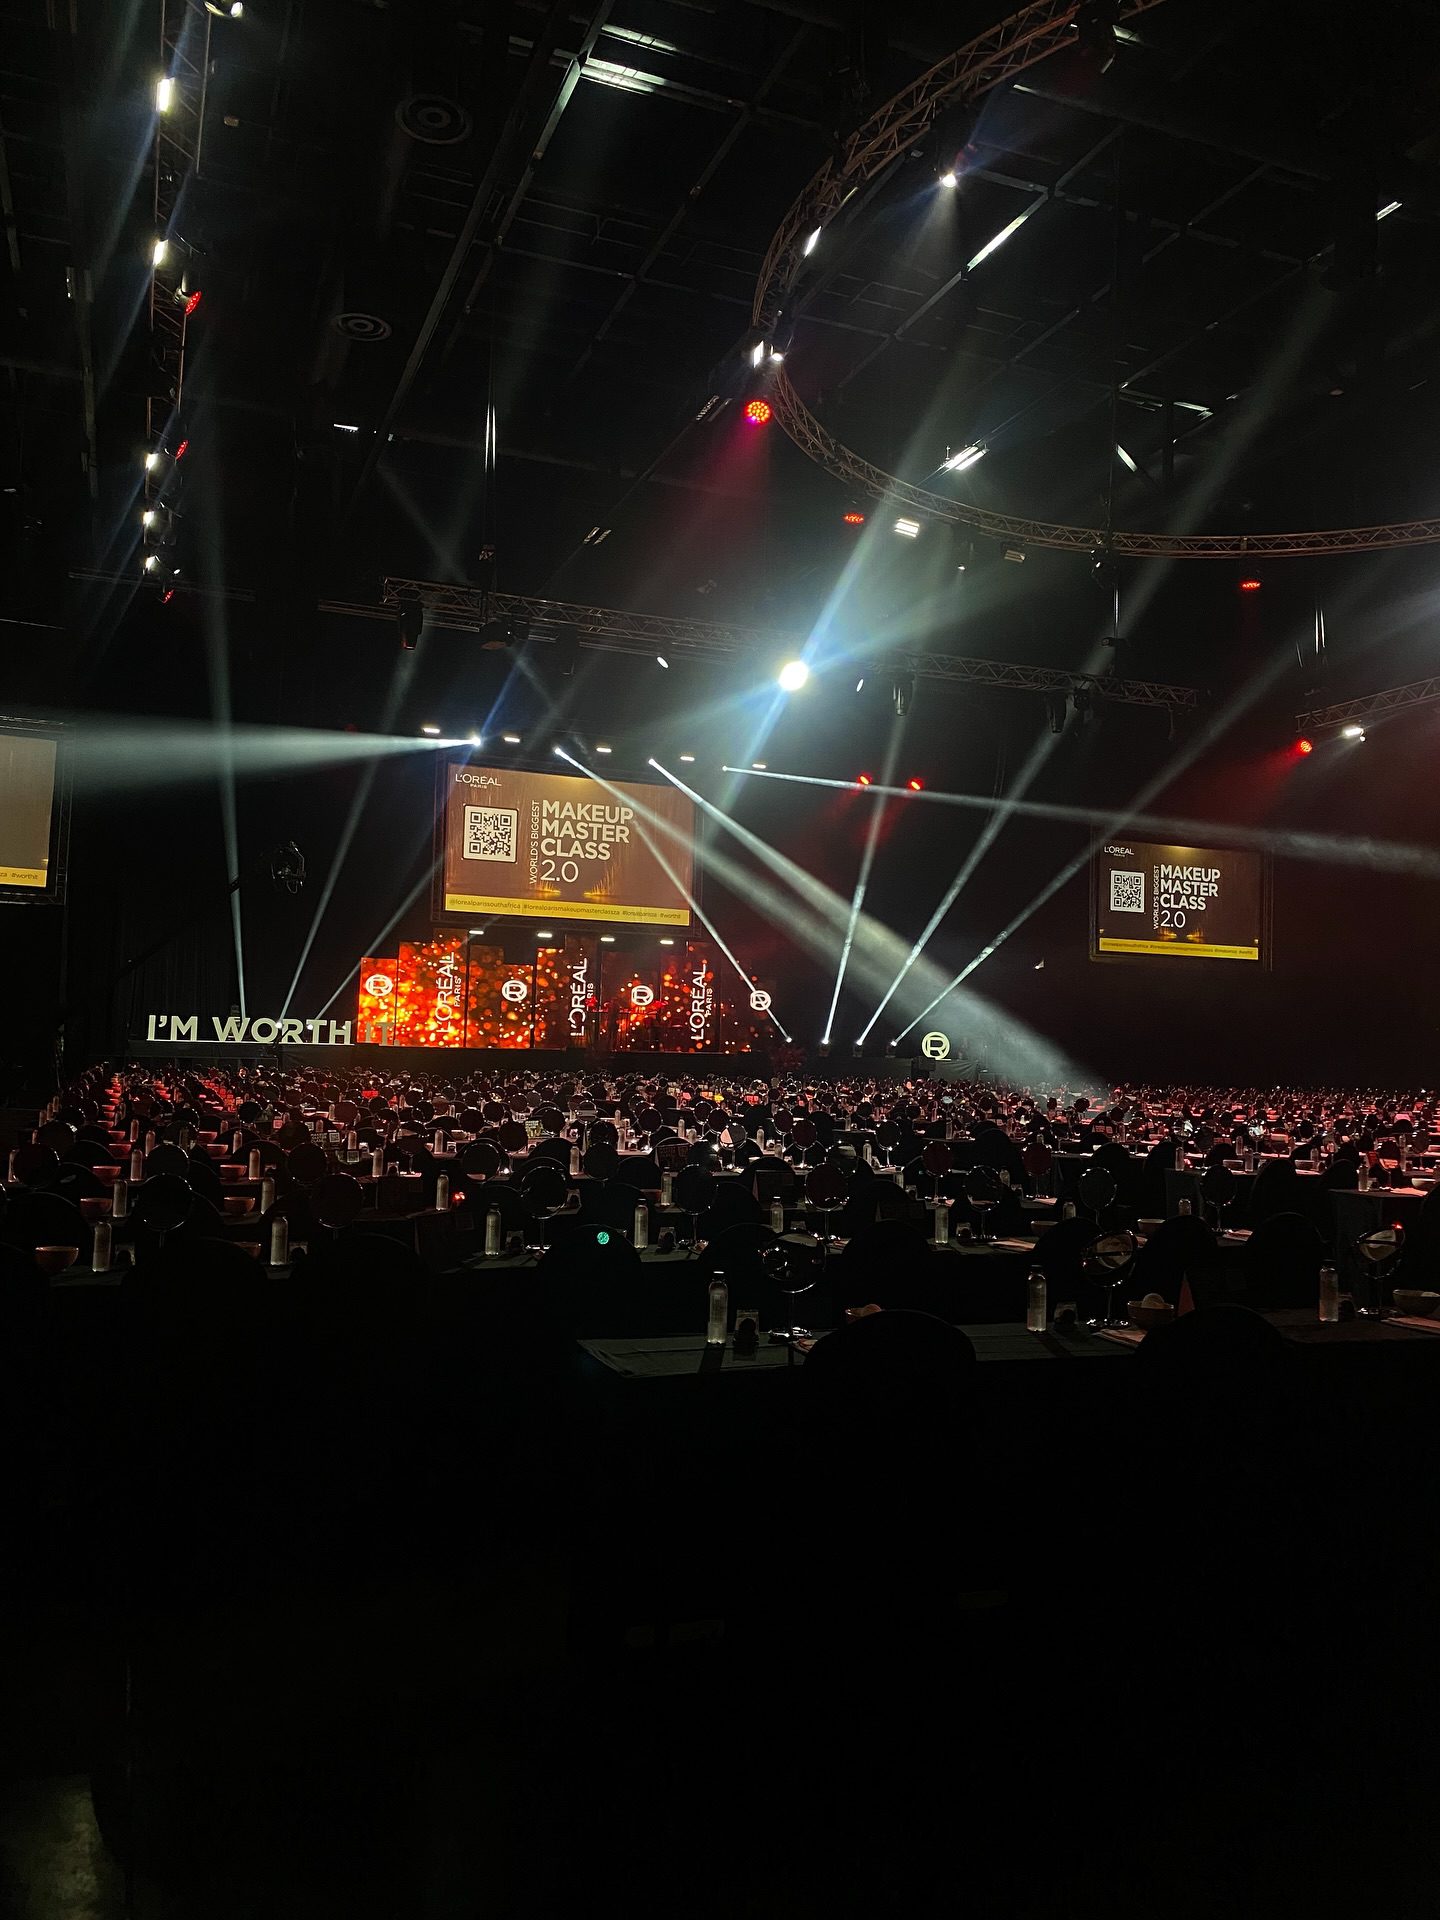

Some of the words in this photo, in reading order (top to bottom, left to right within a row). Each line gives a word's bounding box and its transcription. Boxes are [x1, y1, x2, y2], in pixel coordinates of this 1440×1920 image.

[531, 800, 540, 839] BIGGEST
[542, 799, 634, 825] MAKEUP
[541, 818, 630, 844] MASTER
[540, 837, 611, 861] CLASS
[529, 841, 539, 884] WORLD'S
[540, 859, 579, 883] 2.0
[1160, 864, 1221, 882] MAKEUP
[1160, 879, 1218, 897] MASTER
[1160, 893, 1207, 911] CLASS
[1160, 909, 1186, 928] 2.0
[453, 977, 462, 1007] PARIS
[689, 964, 706, 1040] L'ORÉAL
[704, 988, 714, 1016] PARIS
[148, 1014, 199, 1041] I'M
[212, 1016, 353, 1045] WORTH
